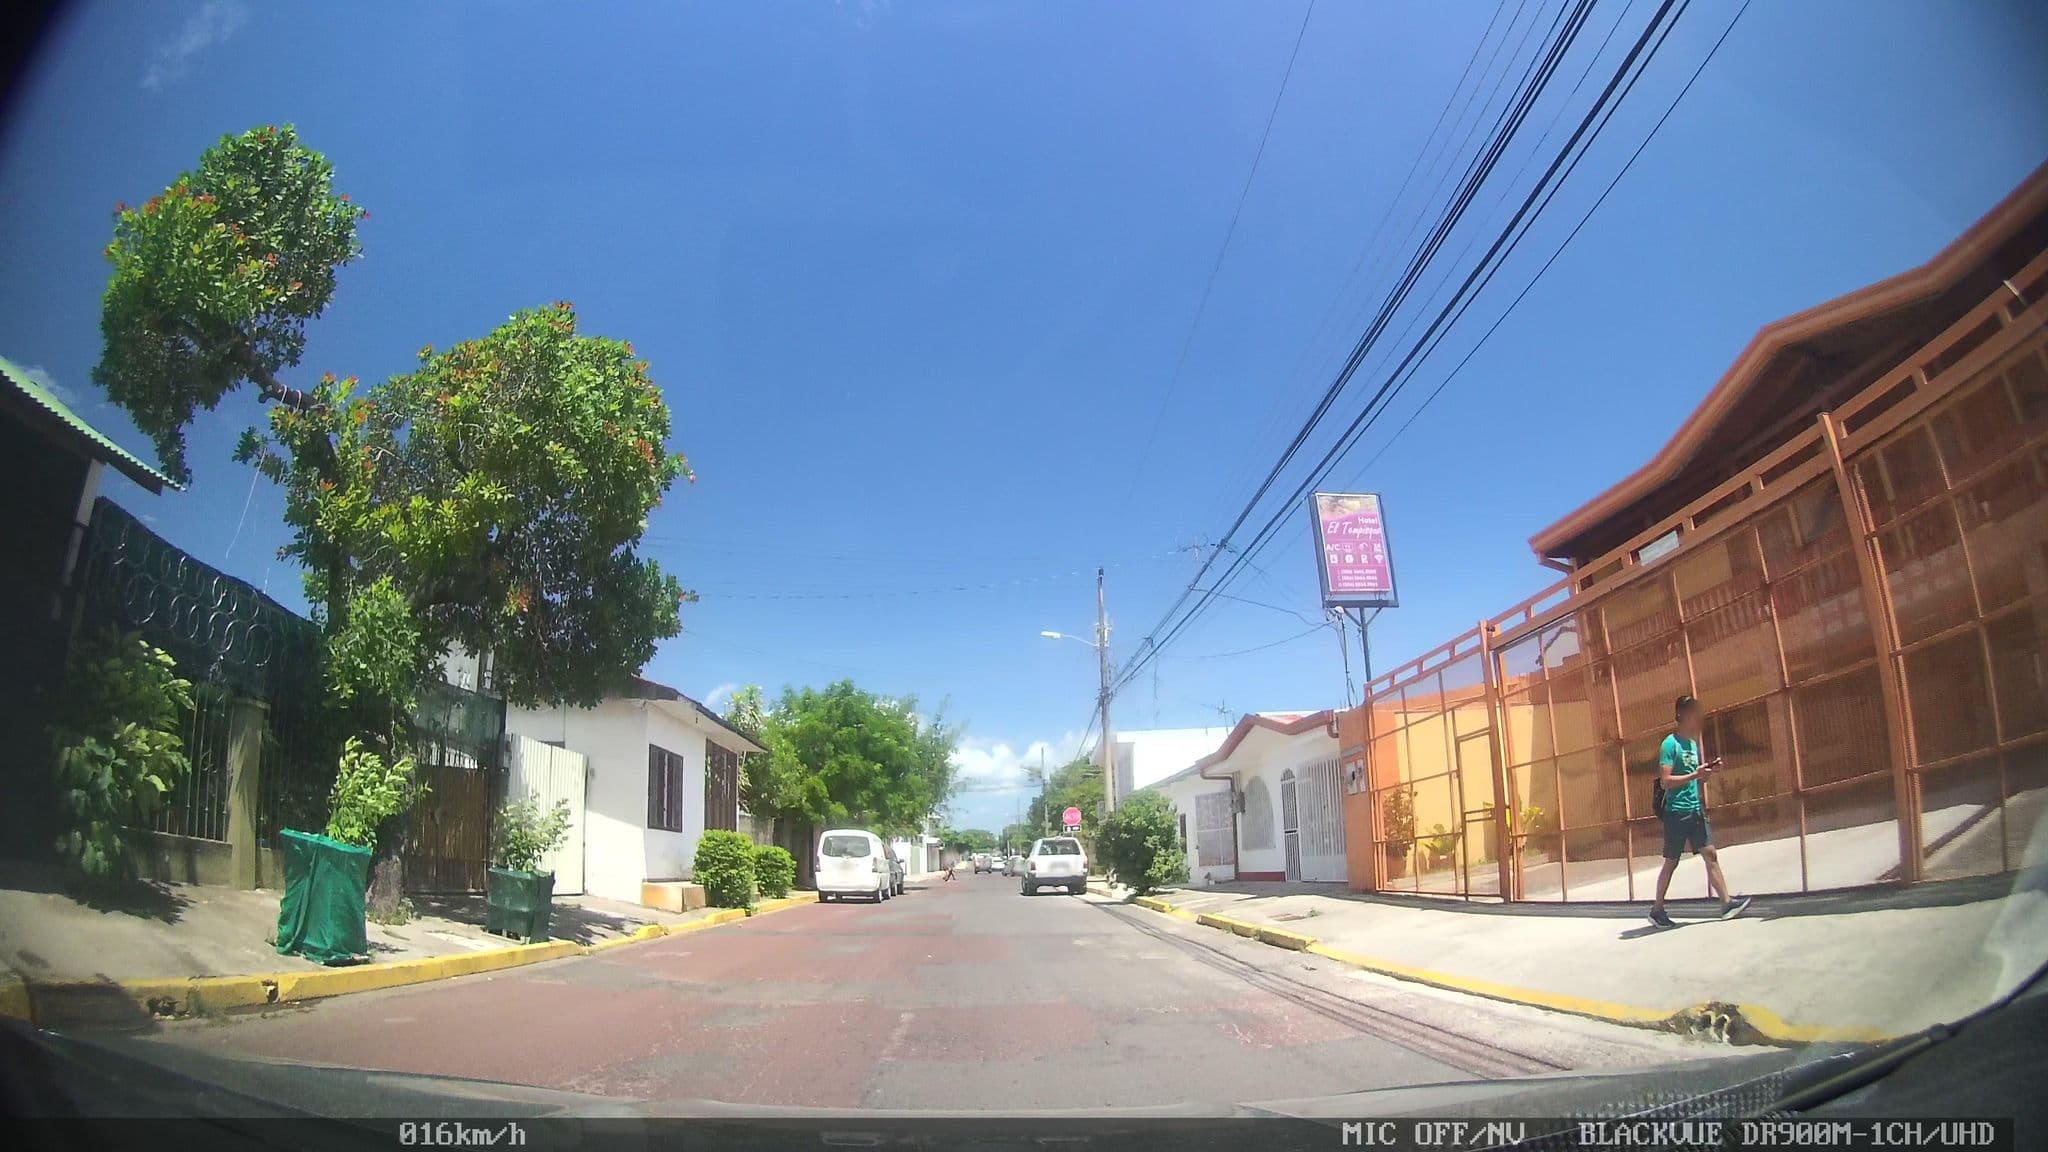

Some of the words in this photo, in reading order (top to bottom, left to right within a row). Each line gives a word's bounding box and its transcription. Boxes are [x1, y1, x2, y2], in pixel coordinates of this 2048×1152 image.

[1358, 516, 1378, 524] Hotel
[1327, 521, 1340, 534] El
[1326, 543, 1341, 551] A/C
